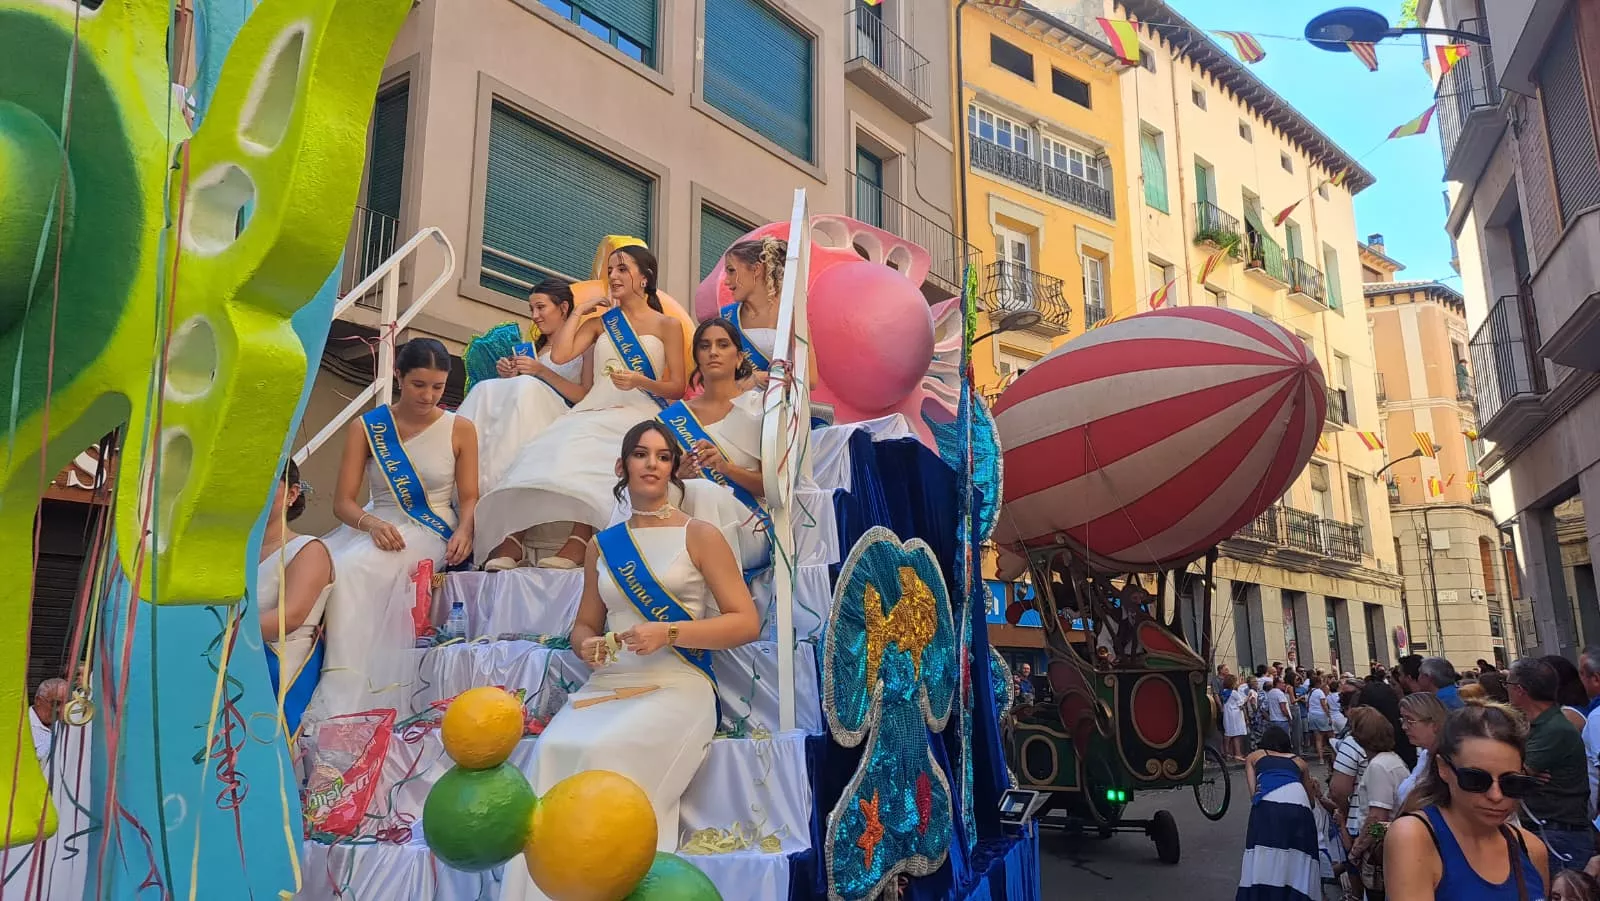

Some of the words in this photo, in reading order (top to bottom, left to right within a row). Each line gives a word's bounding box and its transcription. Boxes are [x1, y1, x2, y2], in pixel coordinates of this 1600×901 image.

[606, 316, 624, 342] Dama
[621, 342, 634, 354] de
[370, 422, 391, 459] Dama
[384, 459, 401, 474] de
[617, 560, 653, 607] Dama
[651, 605, 670, 623] de
